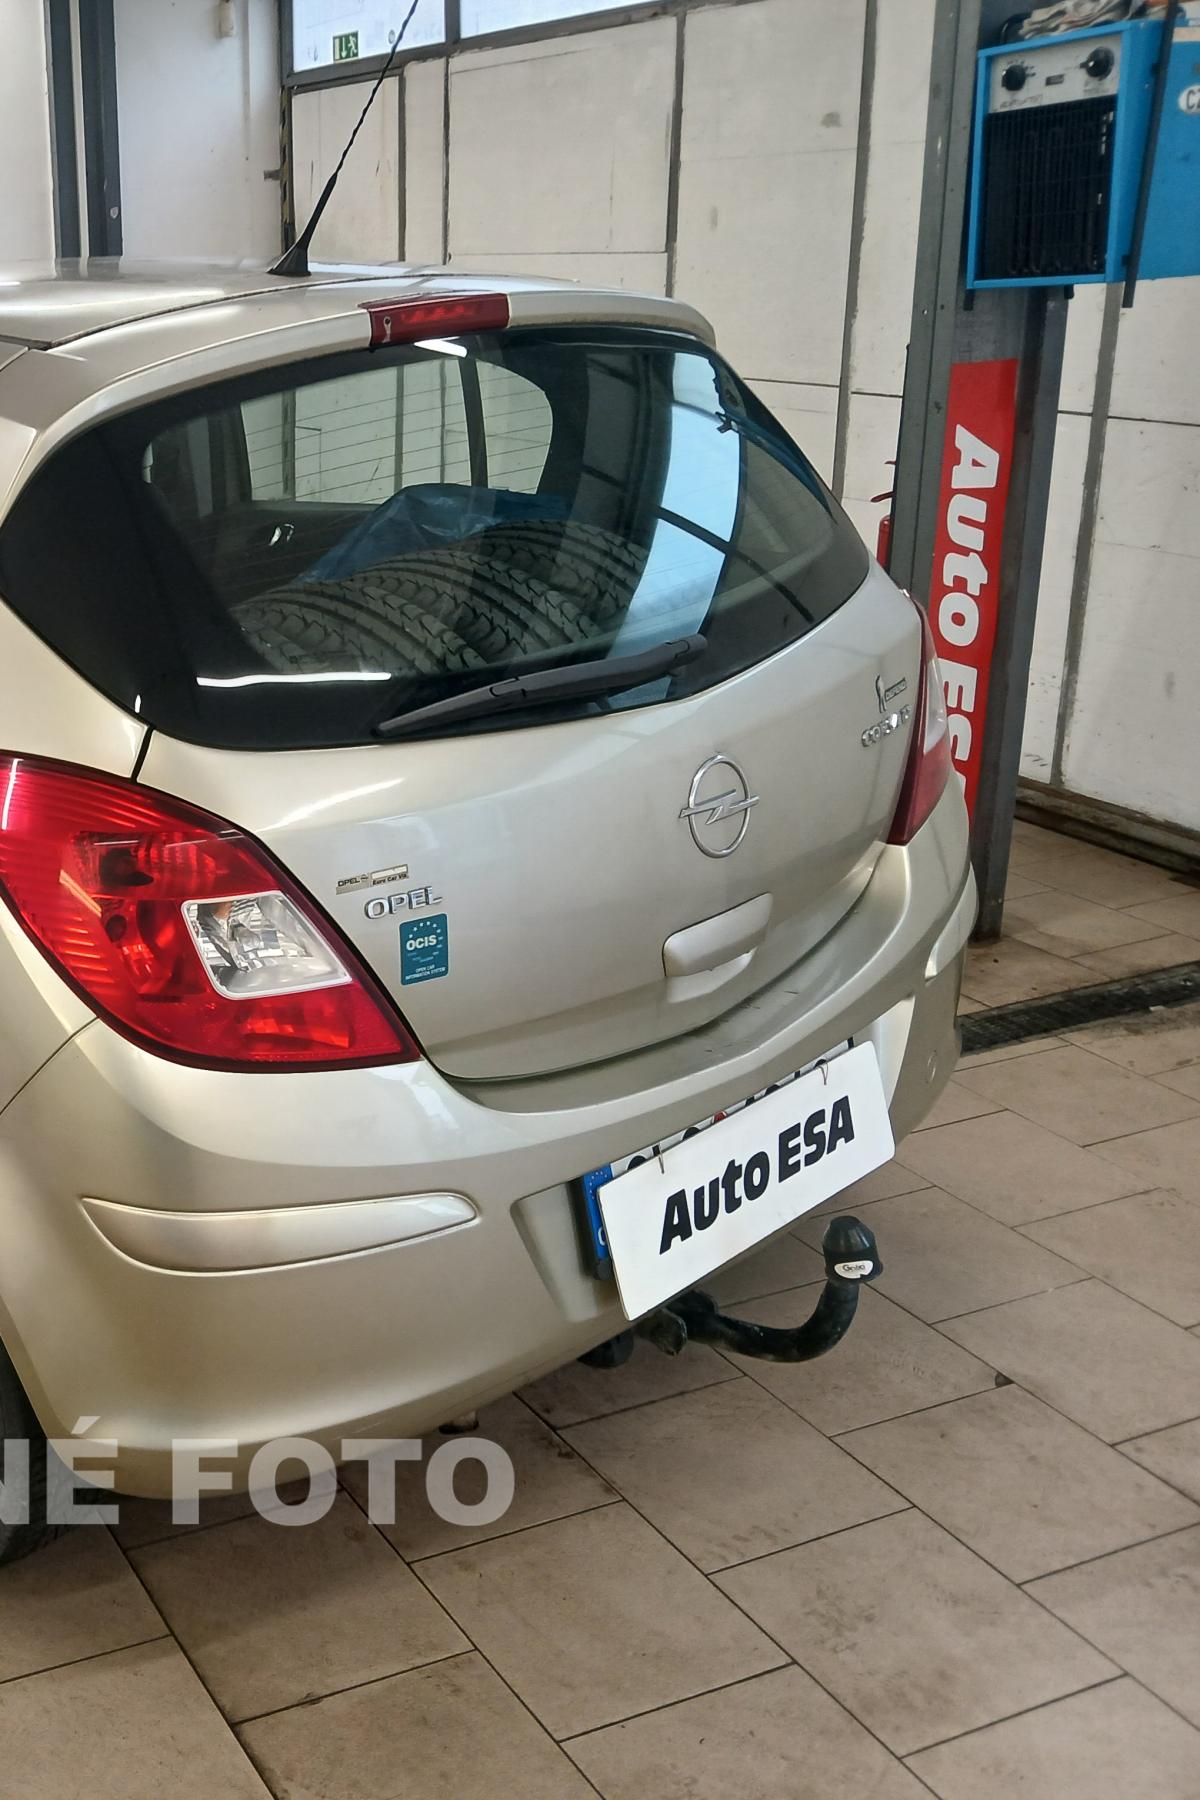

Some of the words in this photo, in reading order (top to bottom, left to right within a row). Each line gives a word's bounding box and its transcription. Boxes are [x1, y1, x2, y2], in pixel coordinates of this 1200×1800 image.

[938, 423, 1000, 647] Auto
[938, 657, 978, 798] ES
[338, 876, 360, 888] OPEL
[364, 886, 443, 919] OPEL
[406, 935, 438, 951] OCIS
[659, 1151, 770, 1255] Auto
[779, 1095, 855, 1183] ESA
